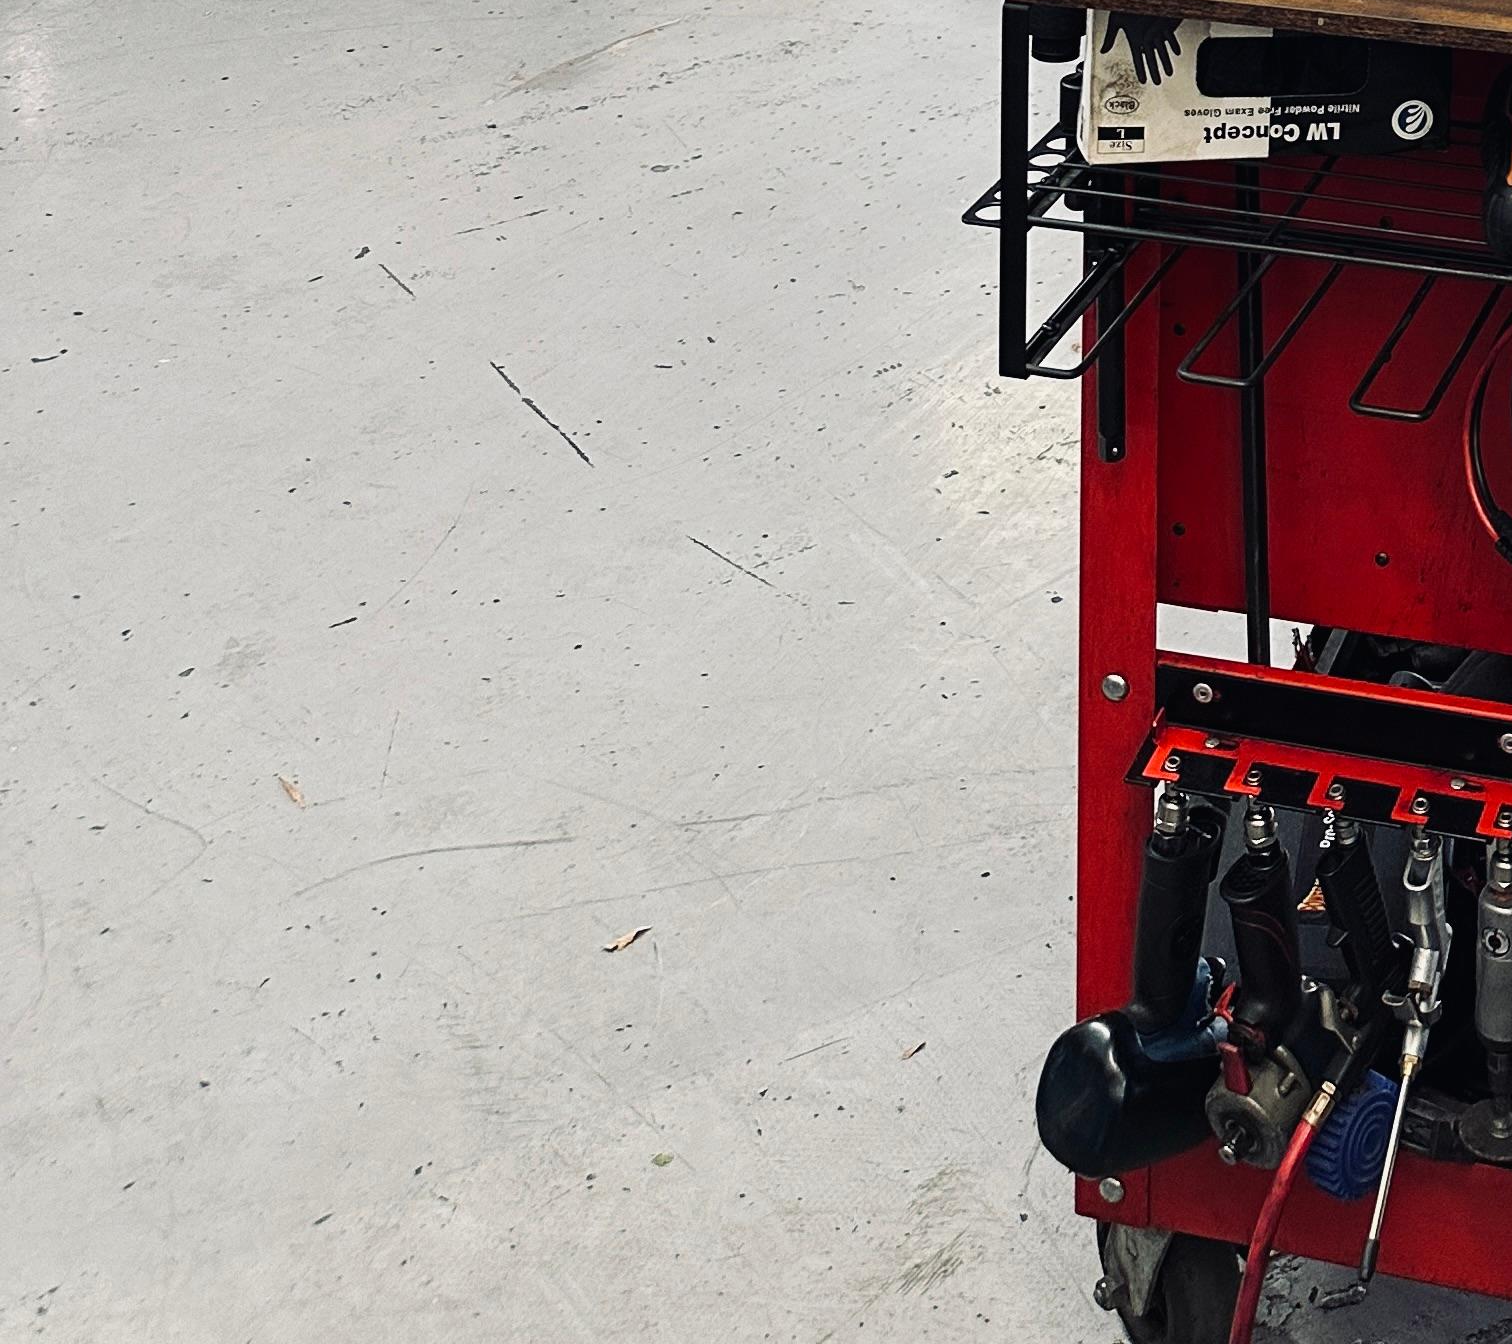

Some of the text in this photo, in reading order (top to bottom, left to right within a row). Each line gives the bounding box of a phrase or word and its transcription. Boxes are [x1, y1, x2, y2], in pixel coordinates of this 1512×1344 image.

[1108, 99, 1136, 112] Black
[1183, 103, 1361, 119] Nitrile Powder Free Exam Gloves
[1115, 128, 1126, 139] L
[1203, 122, 1341, 145] LW Concept
[1109, 140, 1134, 152] Size
